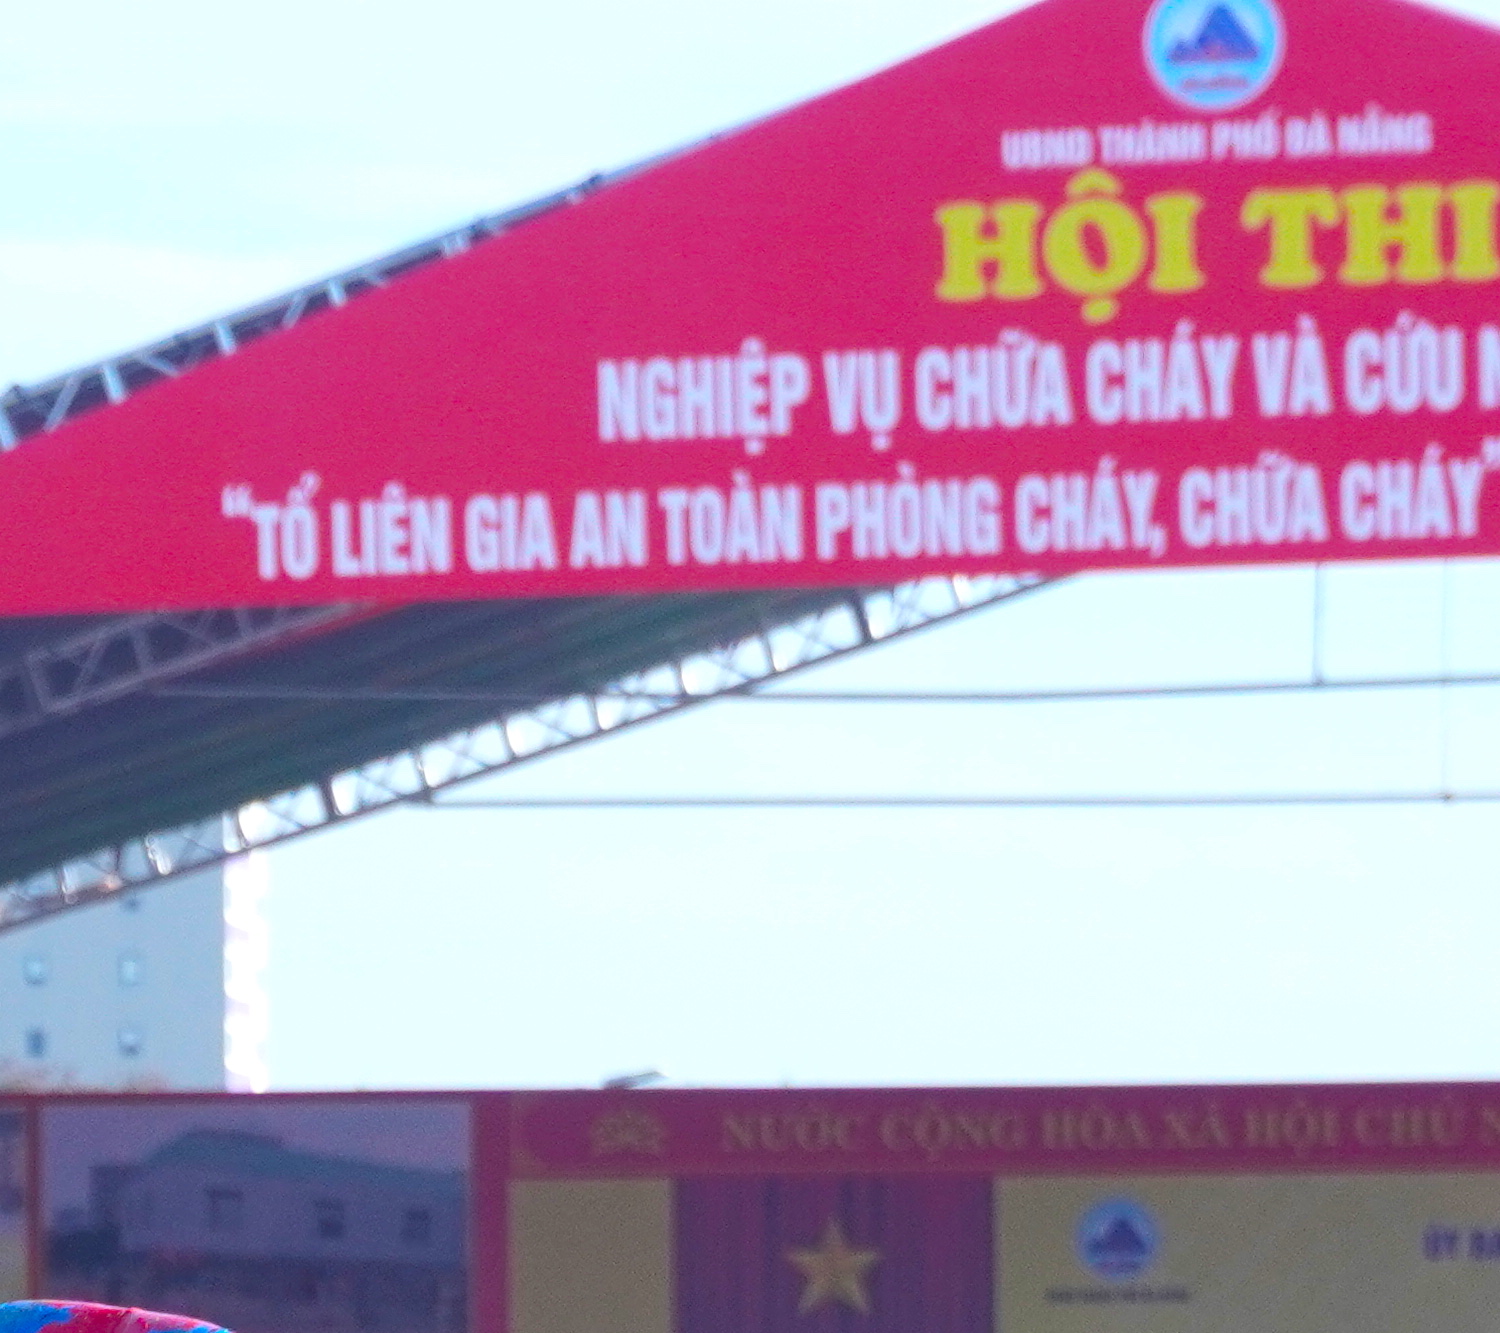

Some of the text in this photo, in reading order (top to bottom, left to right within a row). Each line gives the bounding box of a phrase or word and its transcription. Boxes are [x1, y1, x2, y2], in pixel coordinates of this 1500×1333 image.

[1100, 116, 1205, 163] THÀNH
[1211, 105, 1281, 159] PHỐ
[935, 168, 1203, 322] HỘI
[598, 337, 810, 455] NGHIỆP
[822, 348, 900, 451] VỤ
[914, 328, 1074, 431] CHỮA
[1085, 318, 1241, 424] CHÁY
[1251, 312, 1333, 417] VÀ
[1343, 309, 1466, 415] CỨU
[330, 482, 452, 577] LIÊN
[464, 489, 558, 574] GIA
[569, 488, 649, 570] AN
[658, 469, 804, 566] TOÀN
[813, 461, 1002, 562] PHÒNG
[1013, 453, 1166, 558] CHÁY,
[1178, 449, 1330, 548] CHỮA
[878, 1101, 1025, 1160] CỘNG
[1243, 1097, 1340, 1157] HỘI
